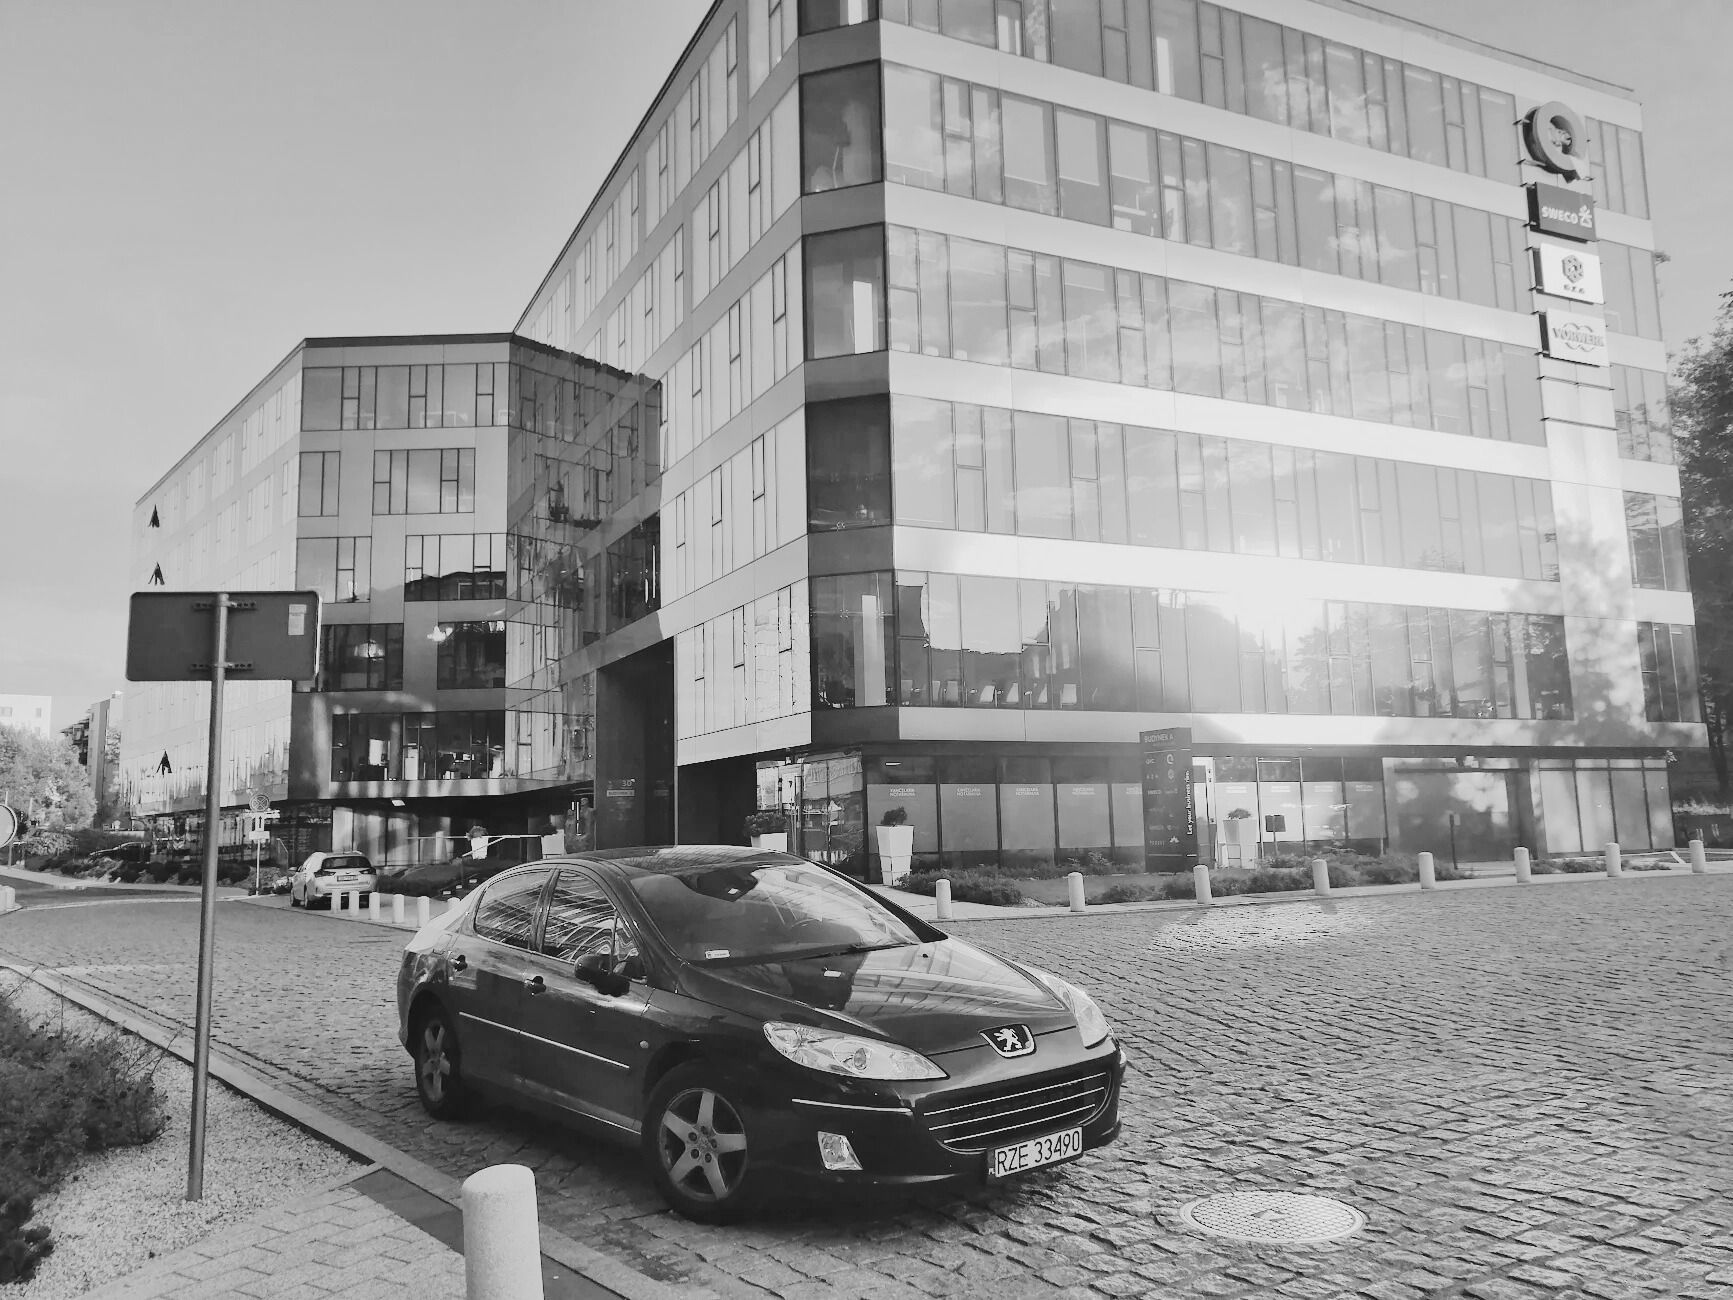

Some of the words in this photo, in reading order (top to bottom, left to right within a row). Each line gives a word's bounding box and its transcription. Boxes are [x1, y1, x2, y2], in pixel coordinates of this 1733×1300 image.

[1541, 205, 1578, 225] SWECO
[997, 1144, 1028, 1175] RZE
[1034, 1130, 1080, 1163] 33490
